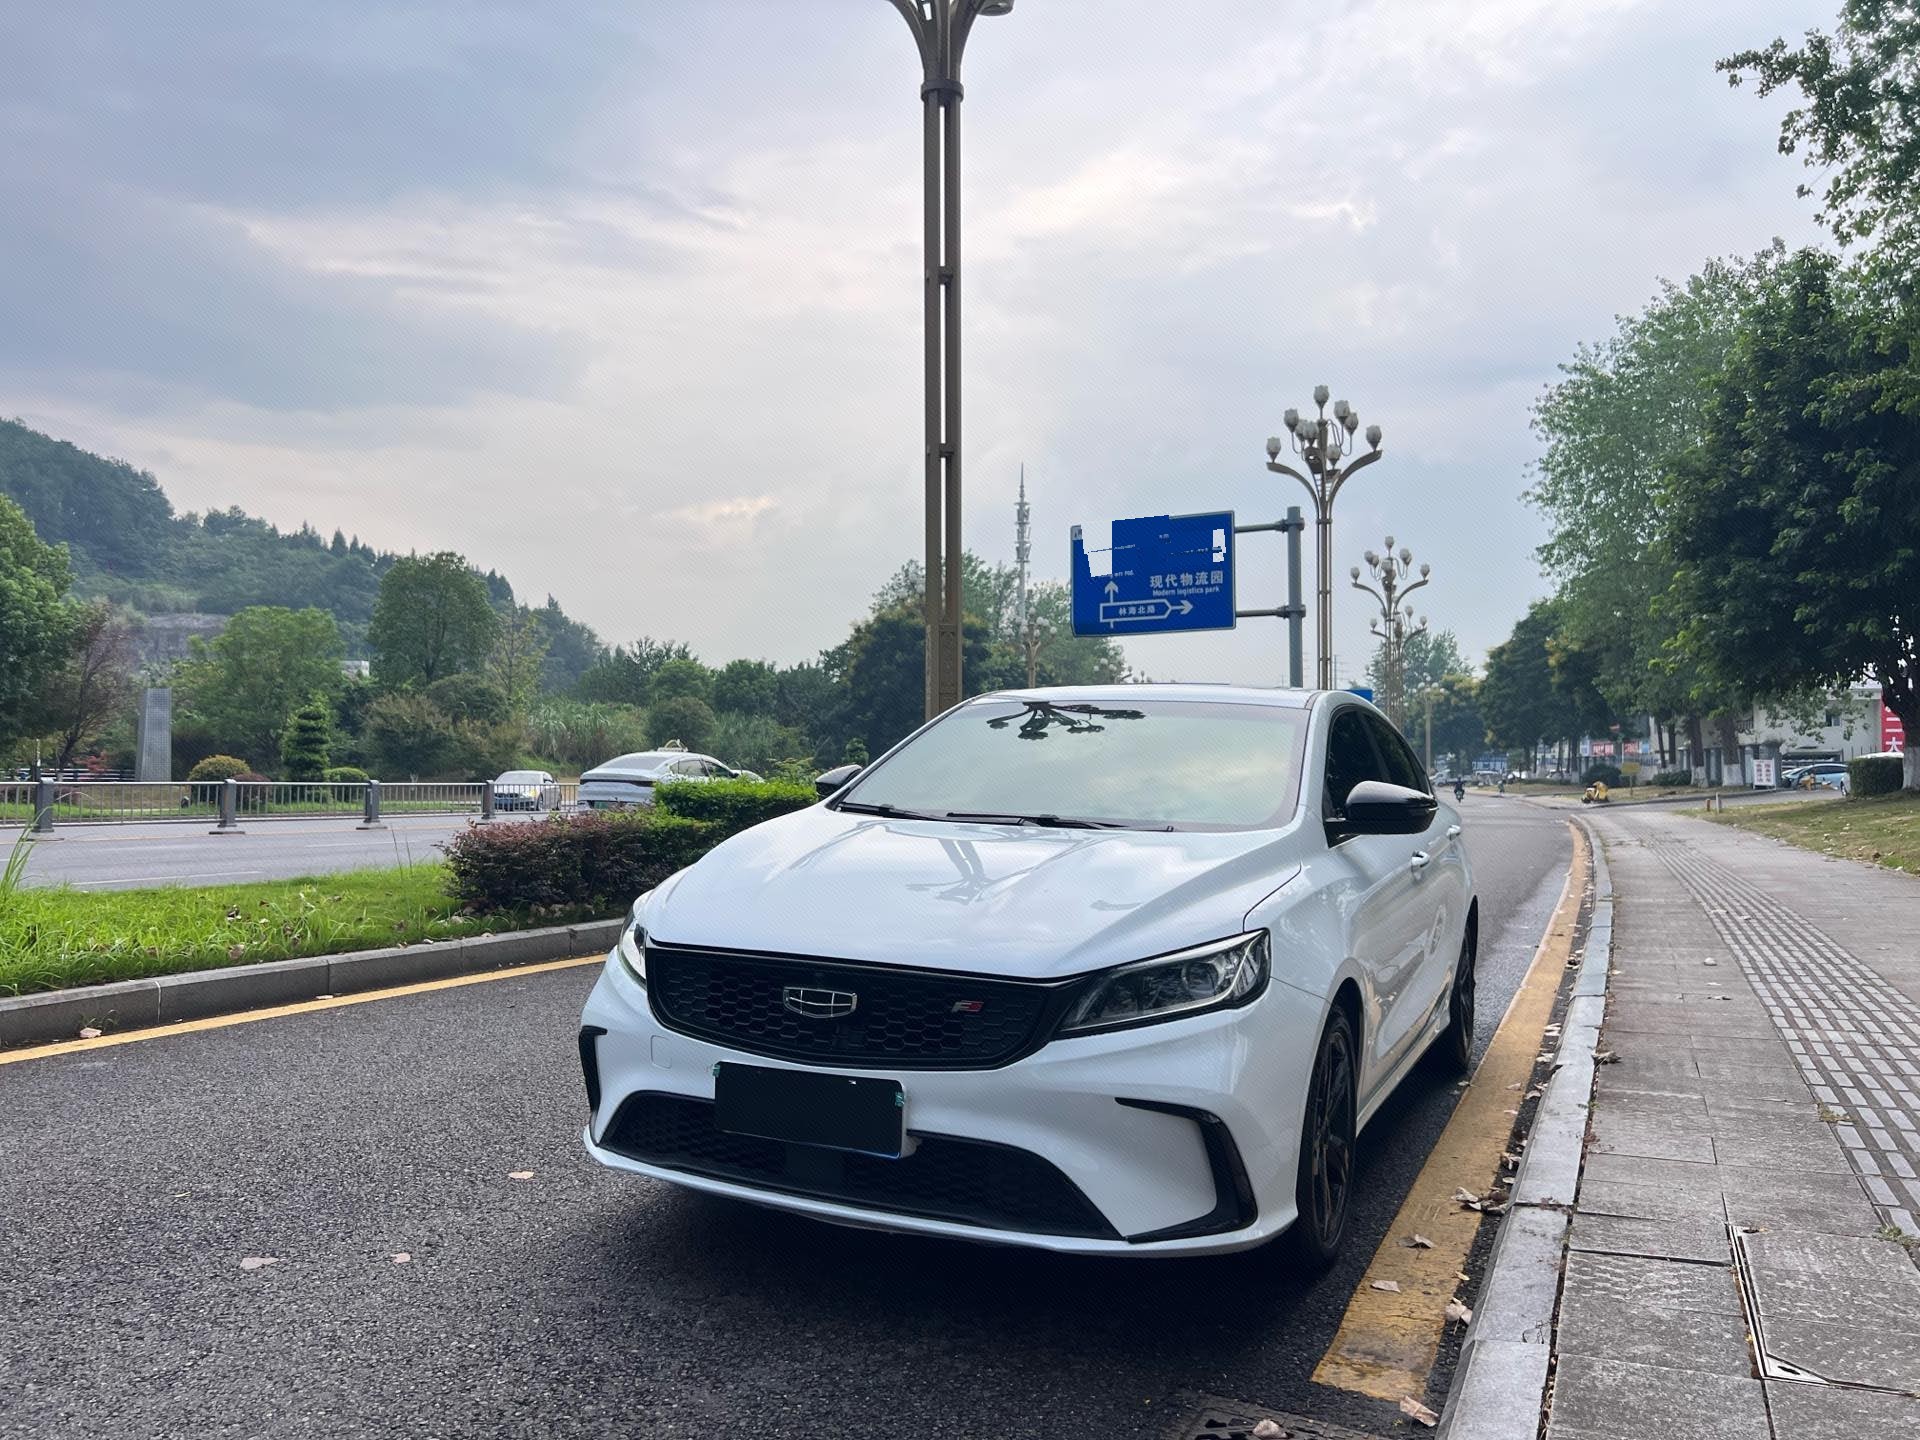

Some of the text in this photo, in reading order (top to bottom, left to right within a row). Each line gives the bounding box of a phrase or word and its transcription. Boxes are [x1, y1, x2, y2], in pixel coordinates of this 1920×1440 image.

[1149, 570, 1224, 589] 现代物流园
[1176, 586, 1204, 597] logistics
[1205, 585, 1220, 595] park
